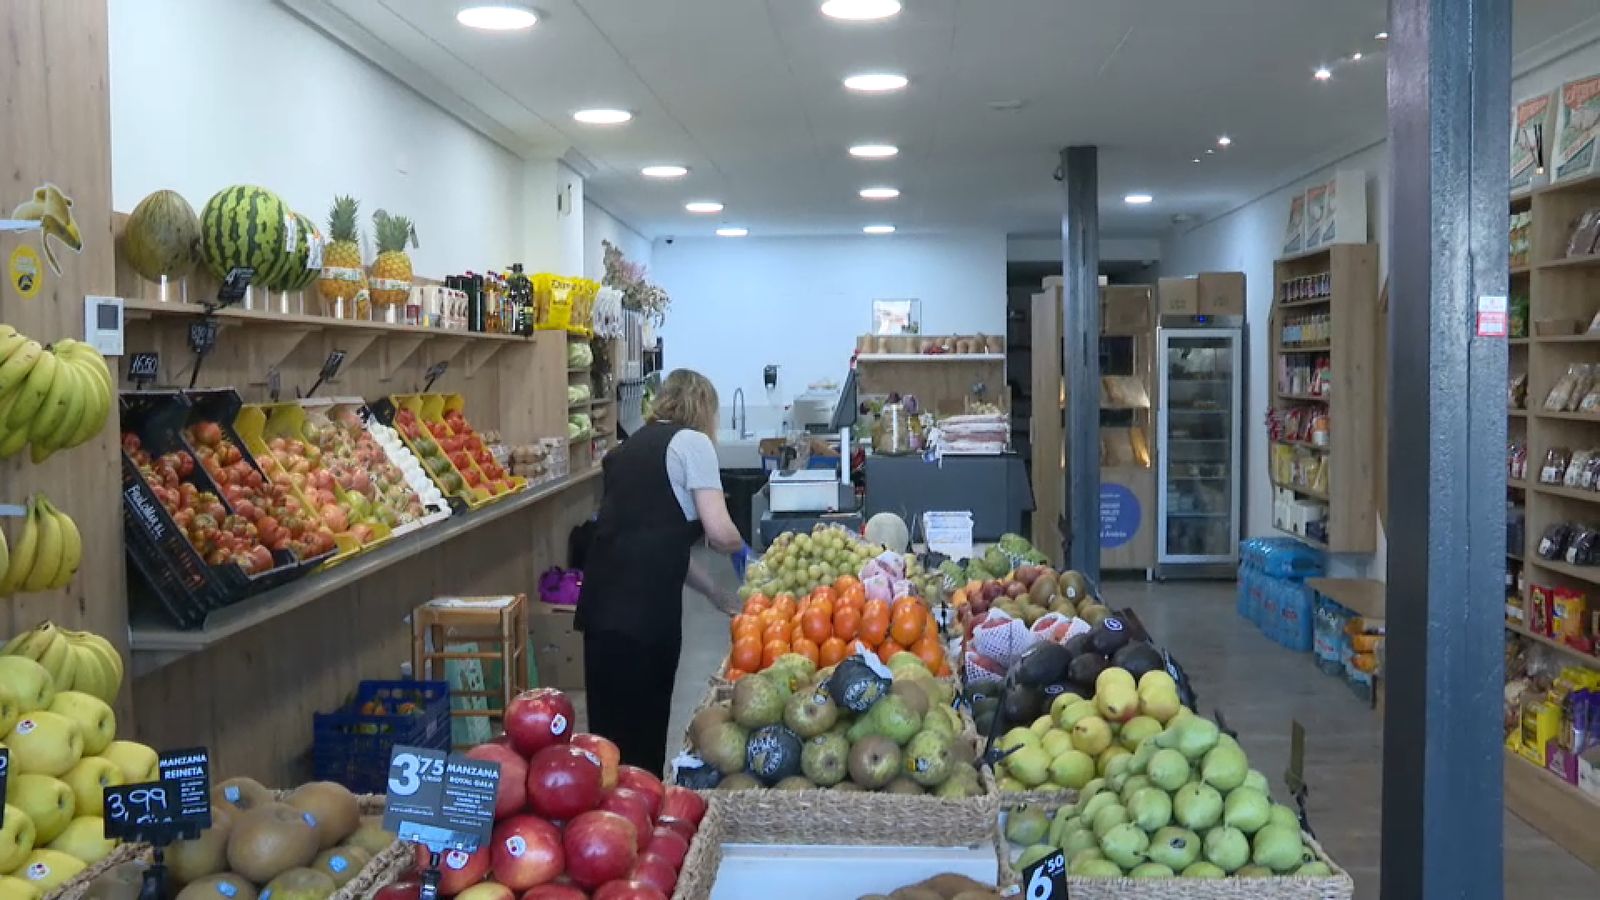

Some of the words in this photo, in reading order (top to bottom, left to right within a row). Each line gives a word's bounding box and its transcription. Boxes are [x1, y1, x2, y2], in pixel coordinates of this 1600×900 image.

[160, 754, 207, 767] MANZANA
[165, 766, 204, 779] REINETA
[446, 763, 499, 779] MANZANA
